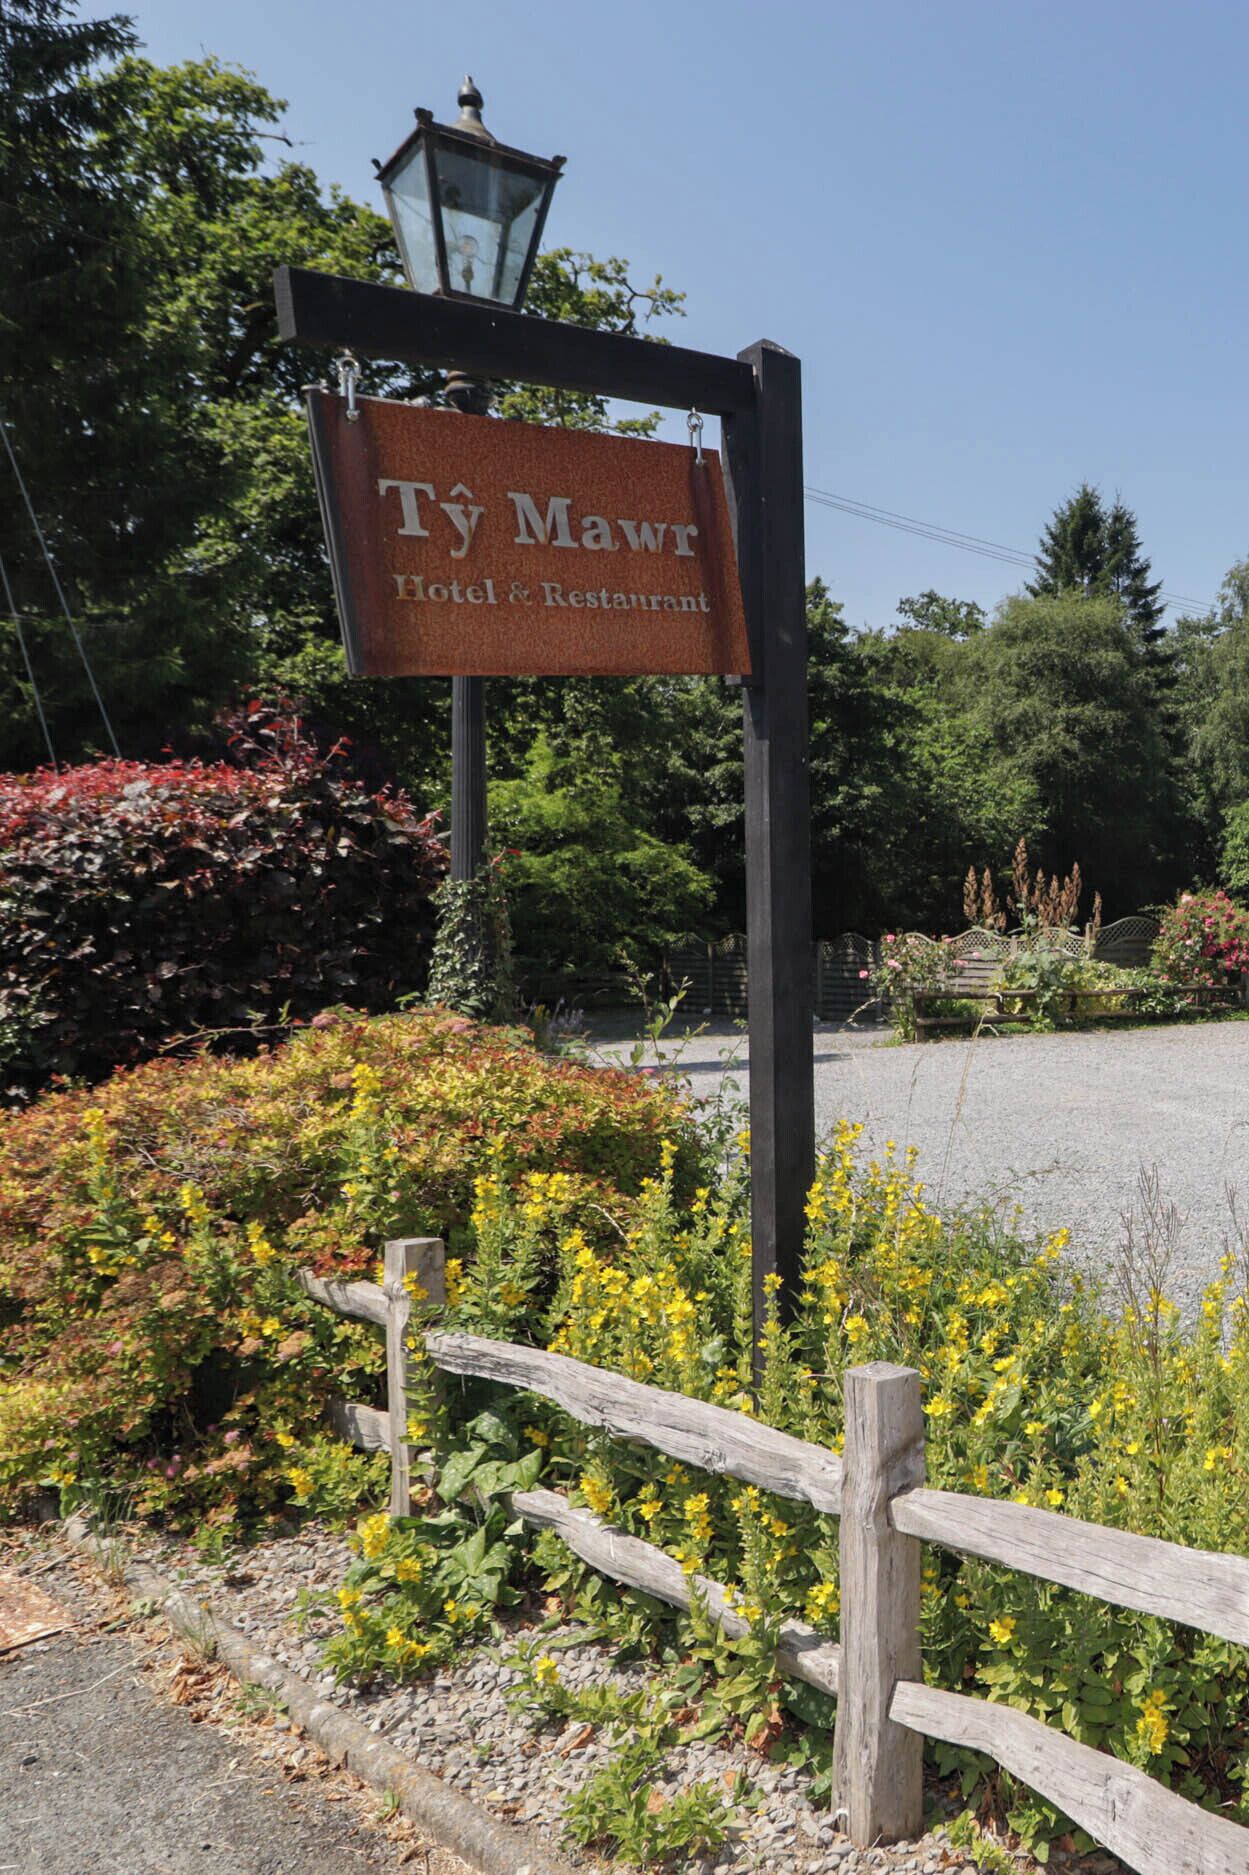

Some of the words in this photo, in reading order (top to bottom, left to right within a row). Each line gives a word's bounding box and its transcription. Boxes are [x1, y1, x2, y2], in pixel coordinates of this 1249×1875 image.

[378, 479, 484, 559] Tŷ
[507, 491, 698, 557] Mawr
[393, 574, 498, 605] Hotel
[509, 582, 533, 605] &
[542, 582, 711, 613] Restaurant
